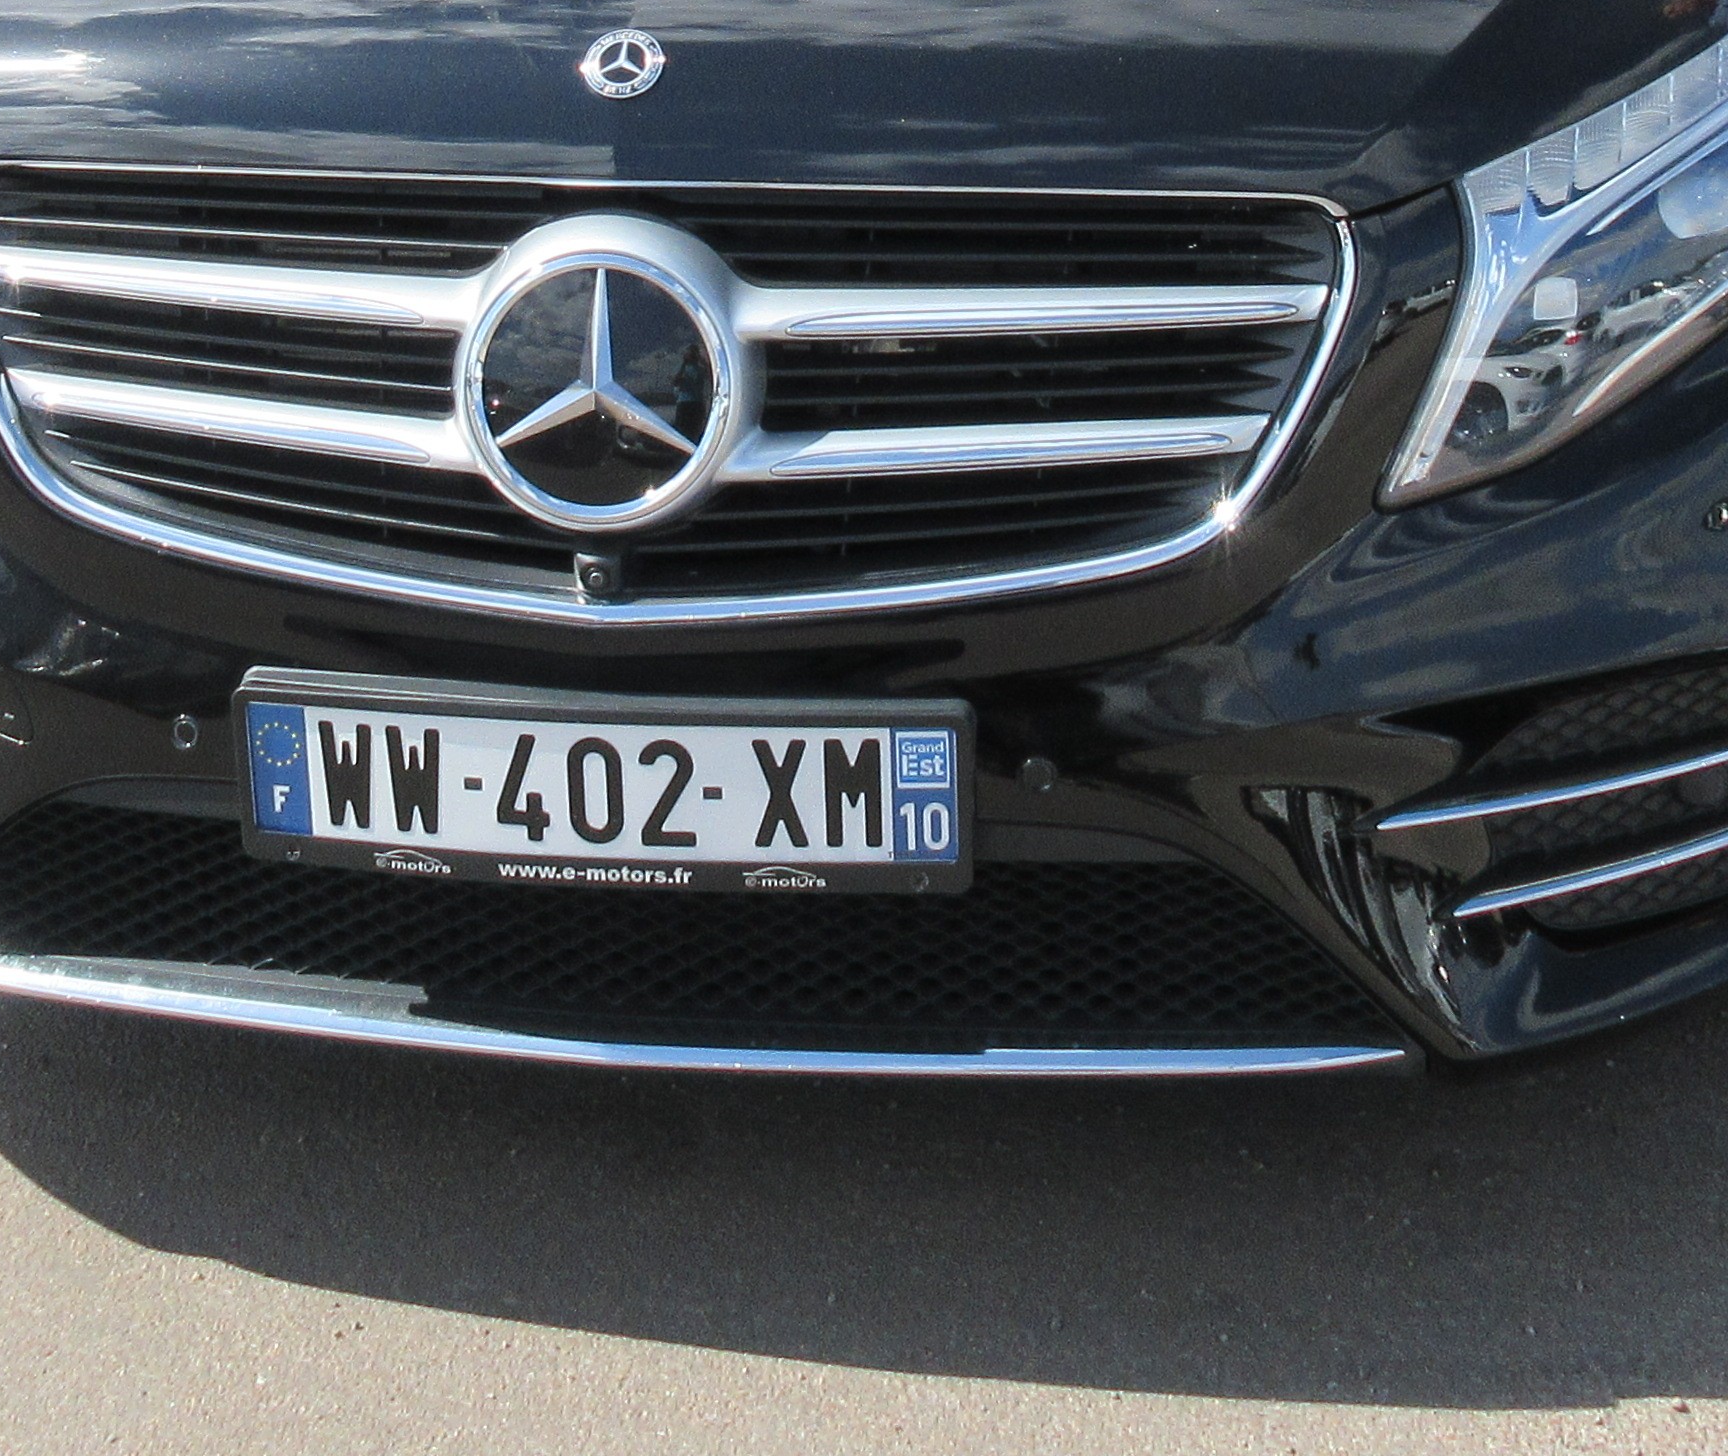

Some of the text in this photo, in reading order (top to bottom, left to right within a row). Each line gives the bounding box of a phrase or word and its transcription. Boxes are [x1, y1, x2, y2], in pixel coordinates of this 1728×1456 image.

[900, 740, 945, 754] Grand
[901, 753, 946, 777] Est
[273, 784, 290, 815] F
[899, 801, 950, 851] 10
[498, 862, 693, 885] www.e-motors.fr
